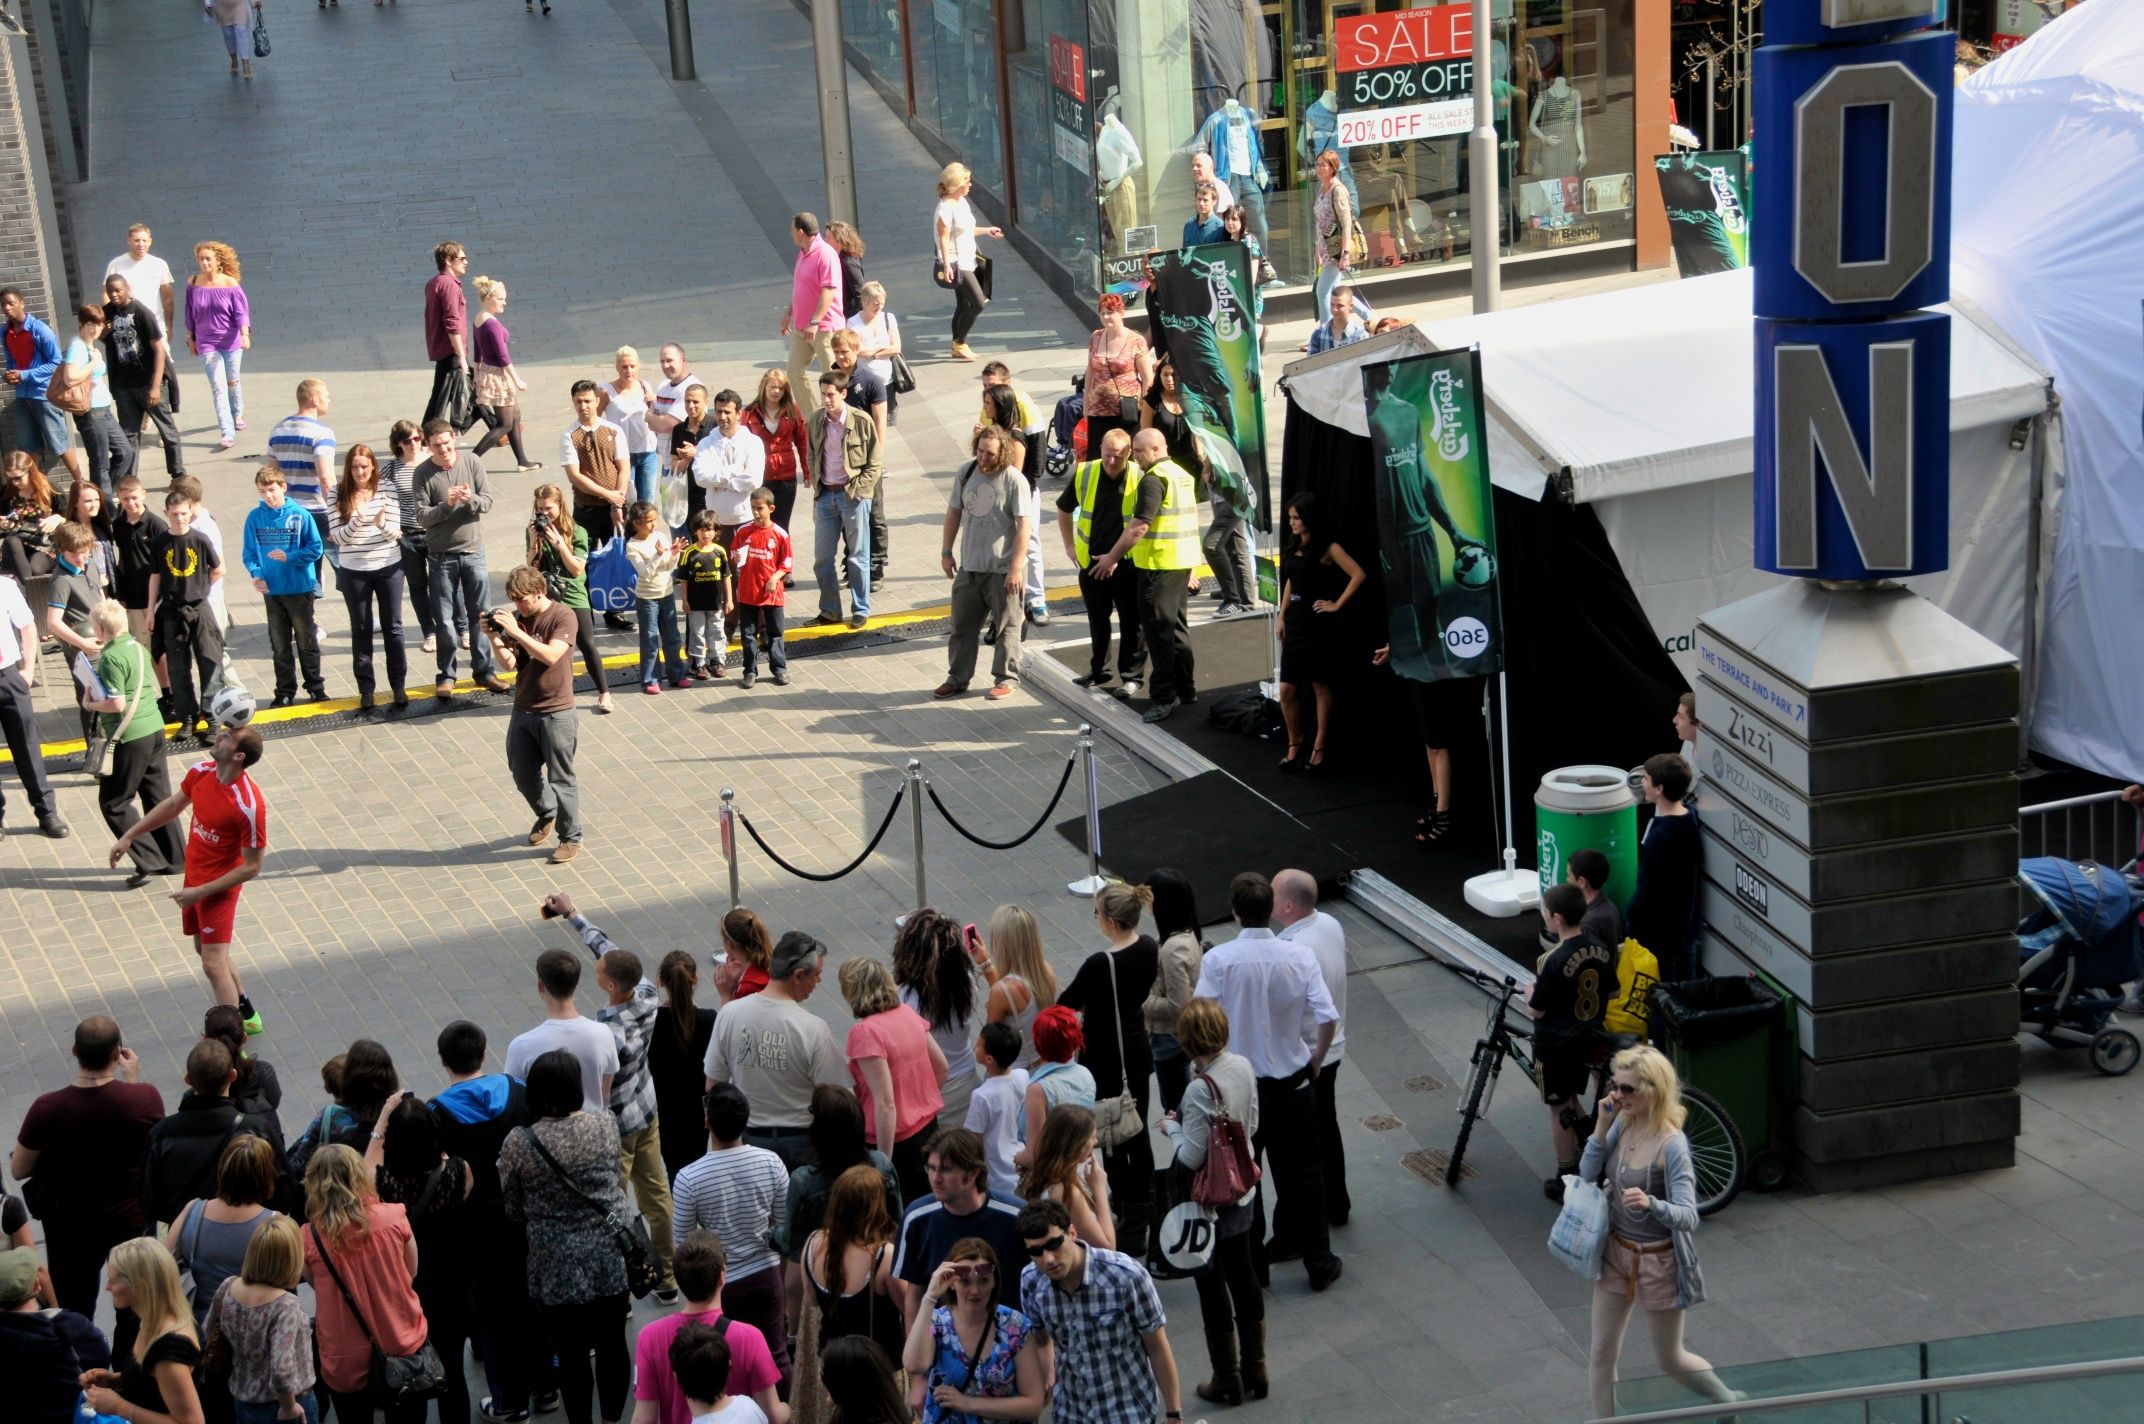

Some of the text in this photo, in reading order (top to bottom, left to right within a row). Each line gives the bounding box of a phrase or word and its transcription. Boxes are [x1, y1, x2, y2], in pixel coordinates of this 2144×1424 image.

[1408, 10, 1432, 19] SEASON
[1354, 12, 1473, 66] SALE
[1053, 44, 1082, 97] SALE
[1354, 62, 1473, 103] 50% OFF
[1342, 113, 1422, 144] 20% OFF
[1428, 112, 1442, 120] ALL
[1444, 108, 1464, 118] SALE
[1428, 120, 1445, 129] THIS
[1562, 224, 1600, 239] Bench
[1775, 0, 1937, 573] ON
[1701, 646, 1792, 716] THE TERRACE AND PARK
[1727, 706, 1774, 766] Zizzi
[1537, 828, 1560, 892] lsberg
[1736, 867, 1767, 907] ODEON
[1563, 945, 1611, 978] GERRARD
[1574, 968, 1600, 1021] 8
[758, 1042, 787, 1060] GUYS
[763, 1030, 787, 1046] OLD
[759, 1054, 787, 1071] RULE
[1169, 1217, 1211, 1254] JD
